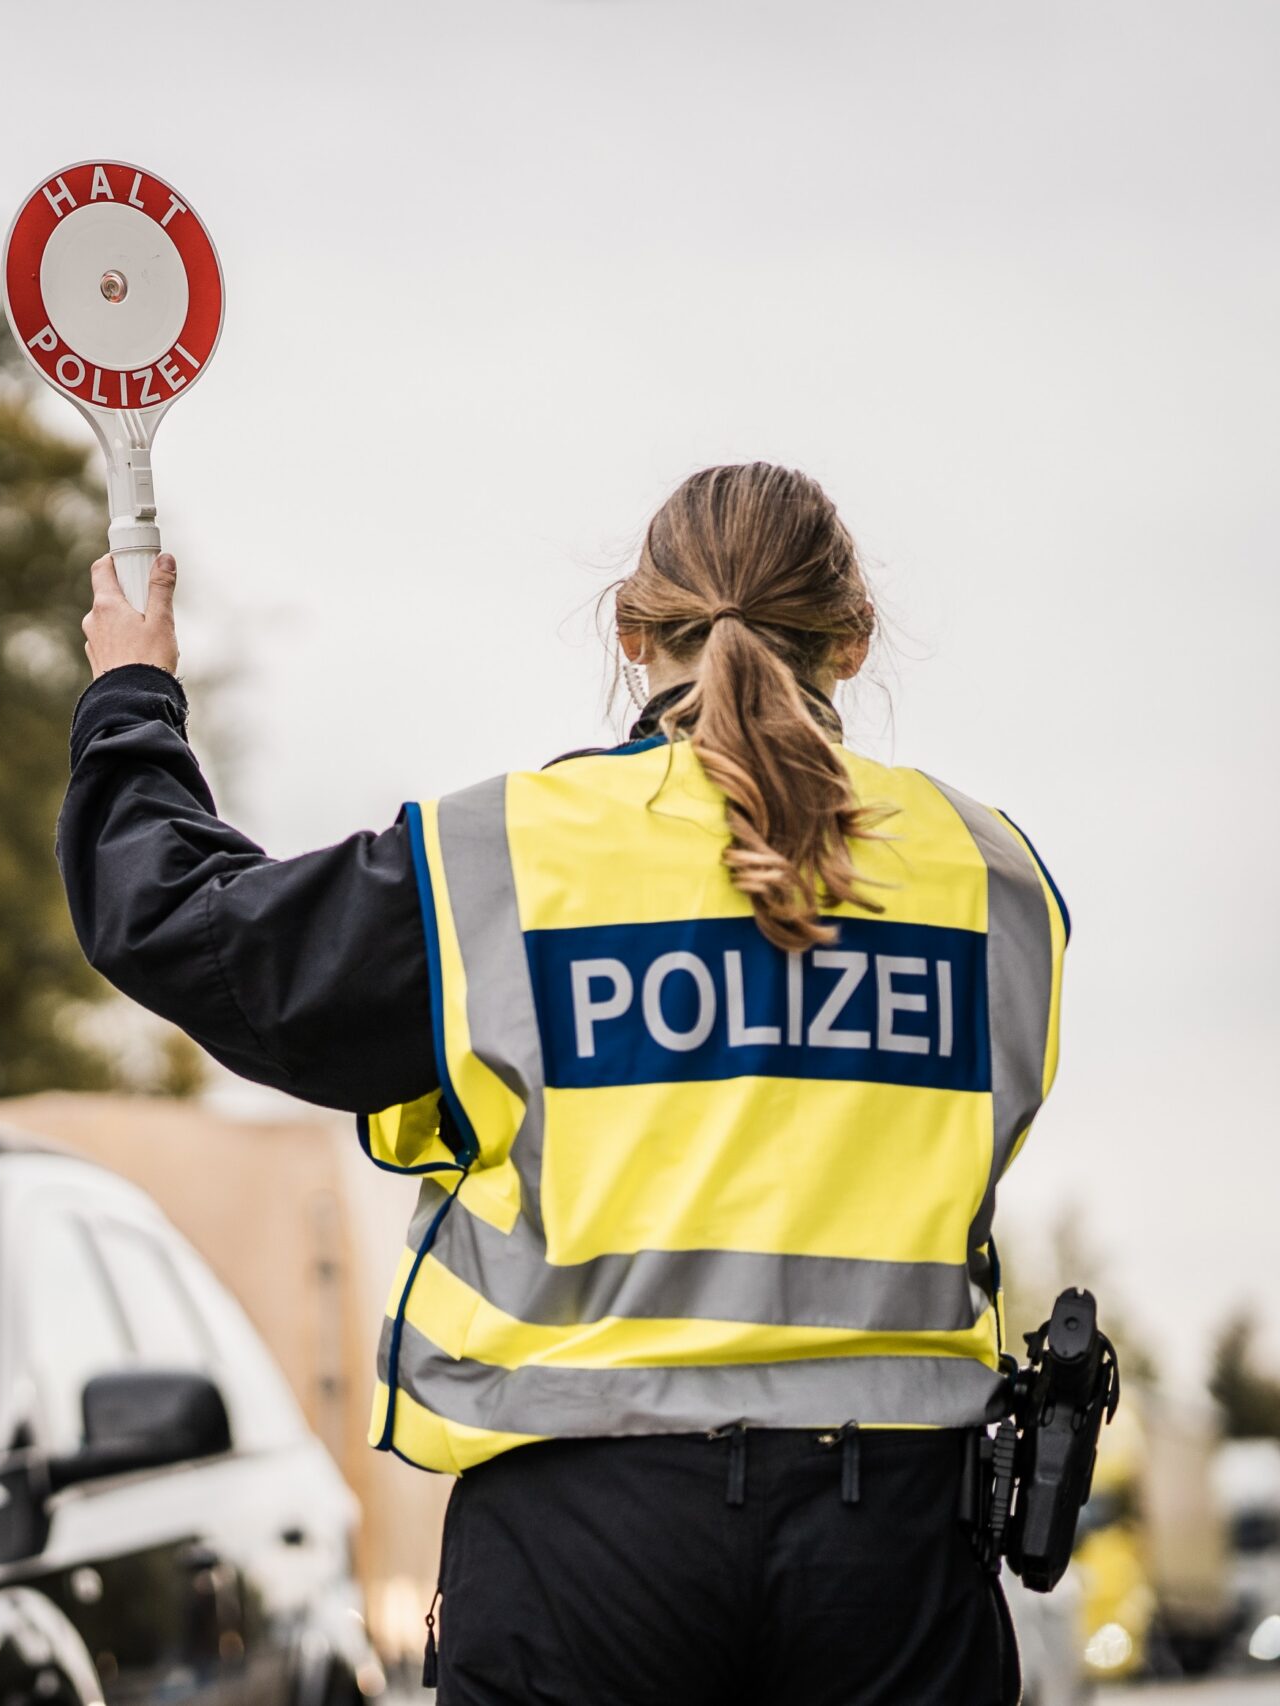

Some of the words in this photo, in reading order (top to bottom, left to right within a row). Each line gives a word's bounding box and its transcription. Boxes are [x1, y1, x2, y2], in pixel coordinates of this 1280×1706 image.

[42, 166, 187, 227] HALT
[27, 324, 201, 407] POLIZEI
[570, 950, 953, 1058] POLIZEI
